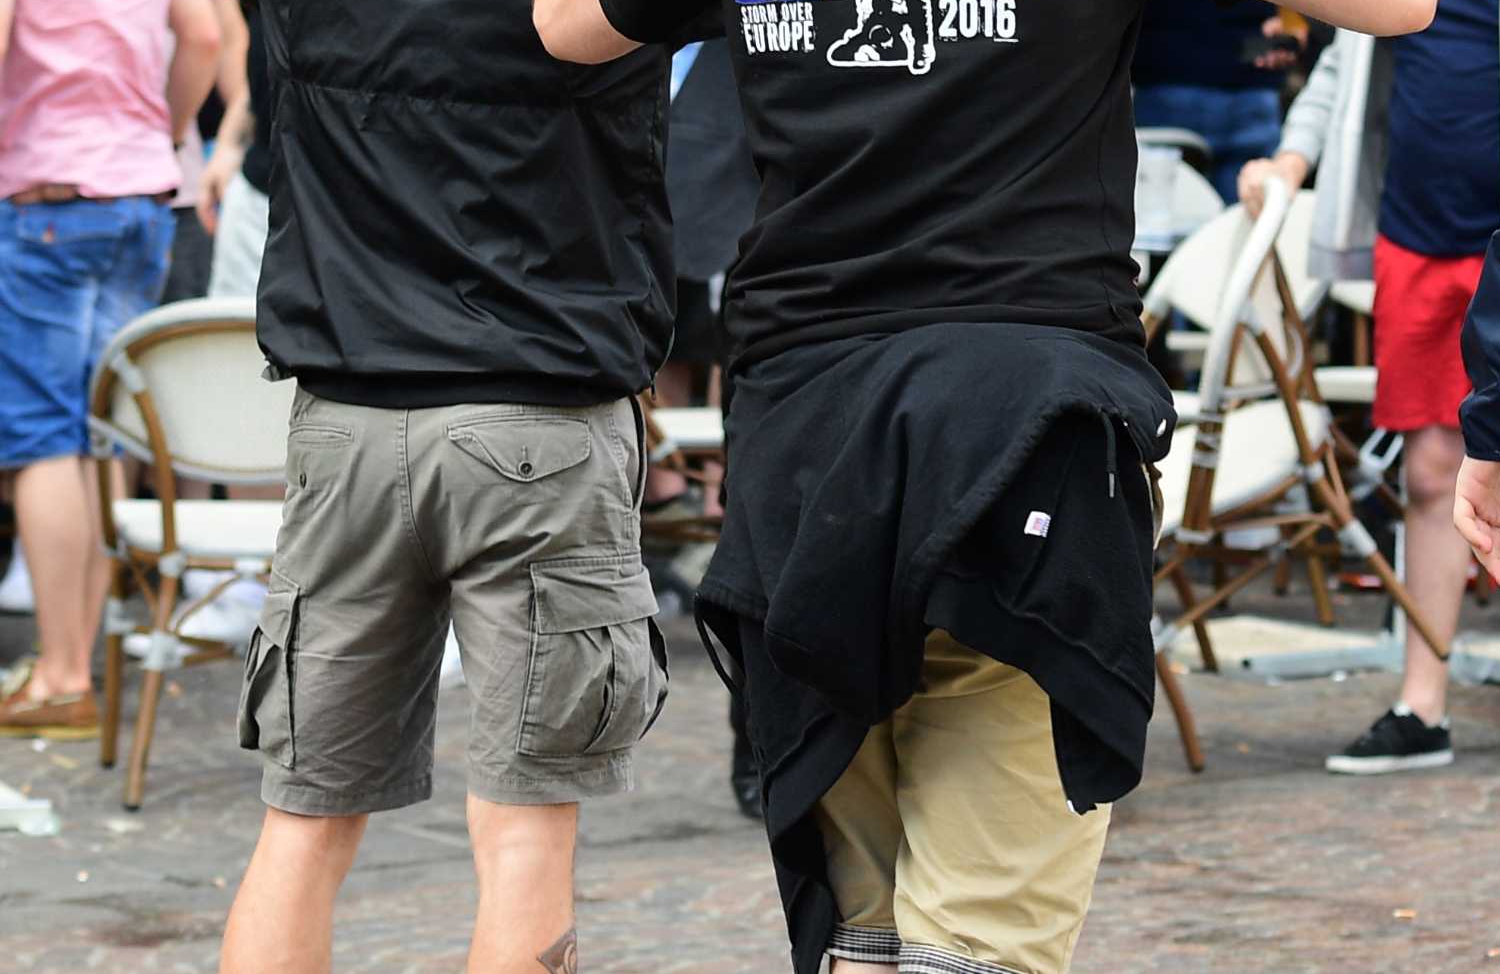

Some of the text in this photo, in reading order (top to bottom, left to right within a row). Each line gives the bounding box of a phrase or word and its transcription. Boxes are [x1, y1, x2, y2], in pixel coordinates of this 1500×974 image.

[740, 1, 814, 24] STORM OVER
[743, 20, 816, 56] EUROPE
